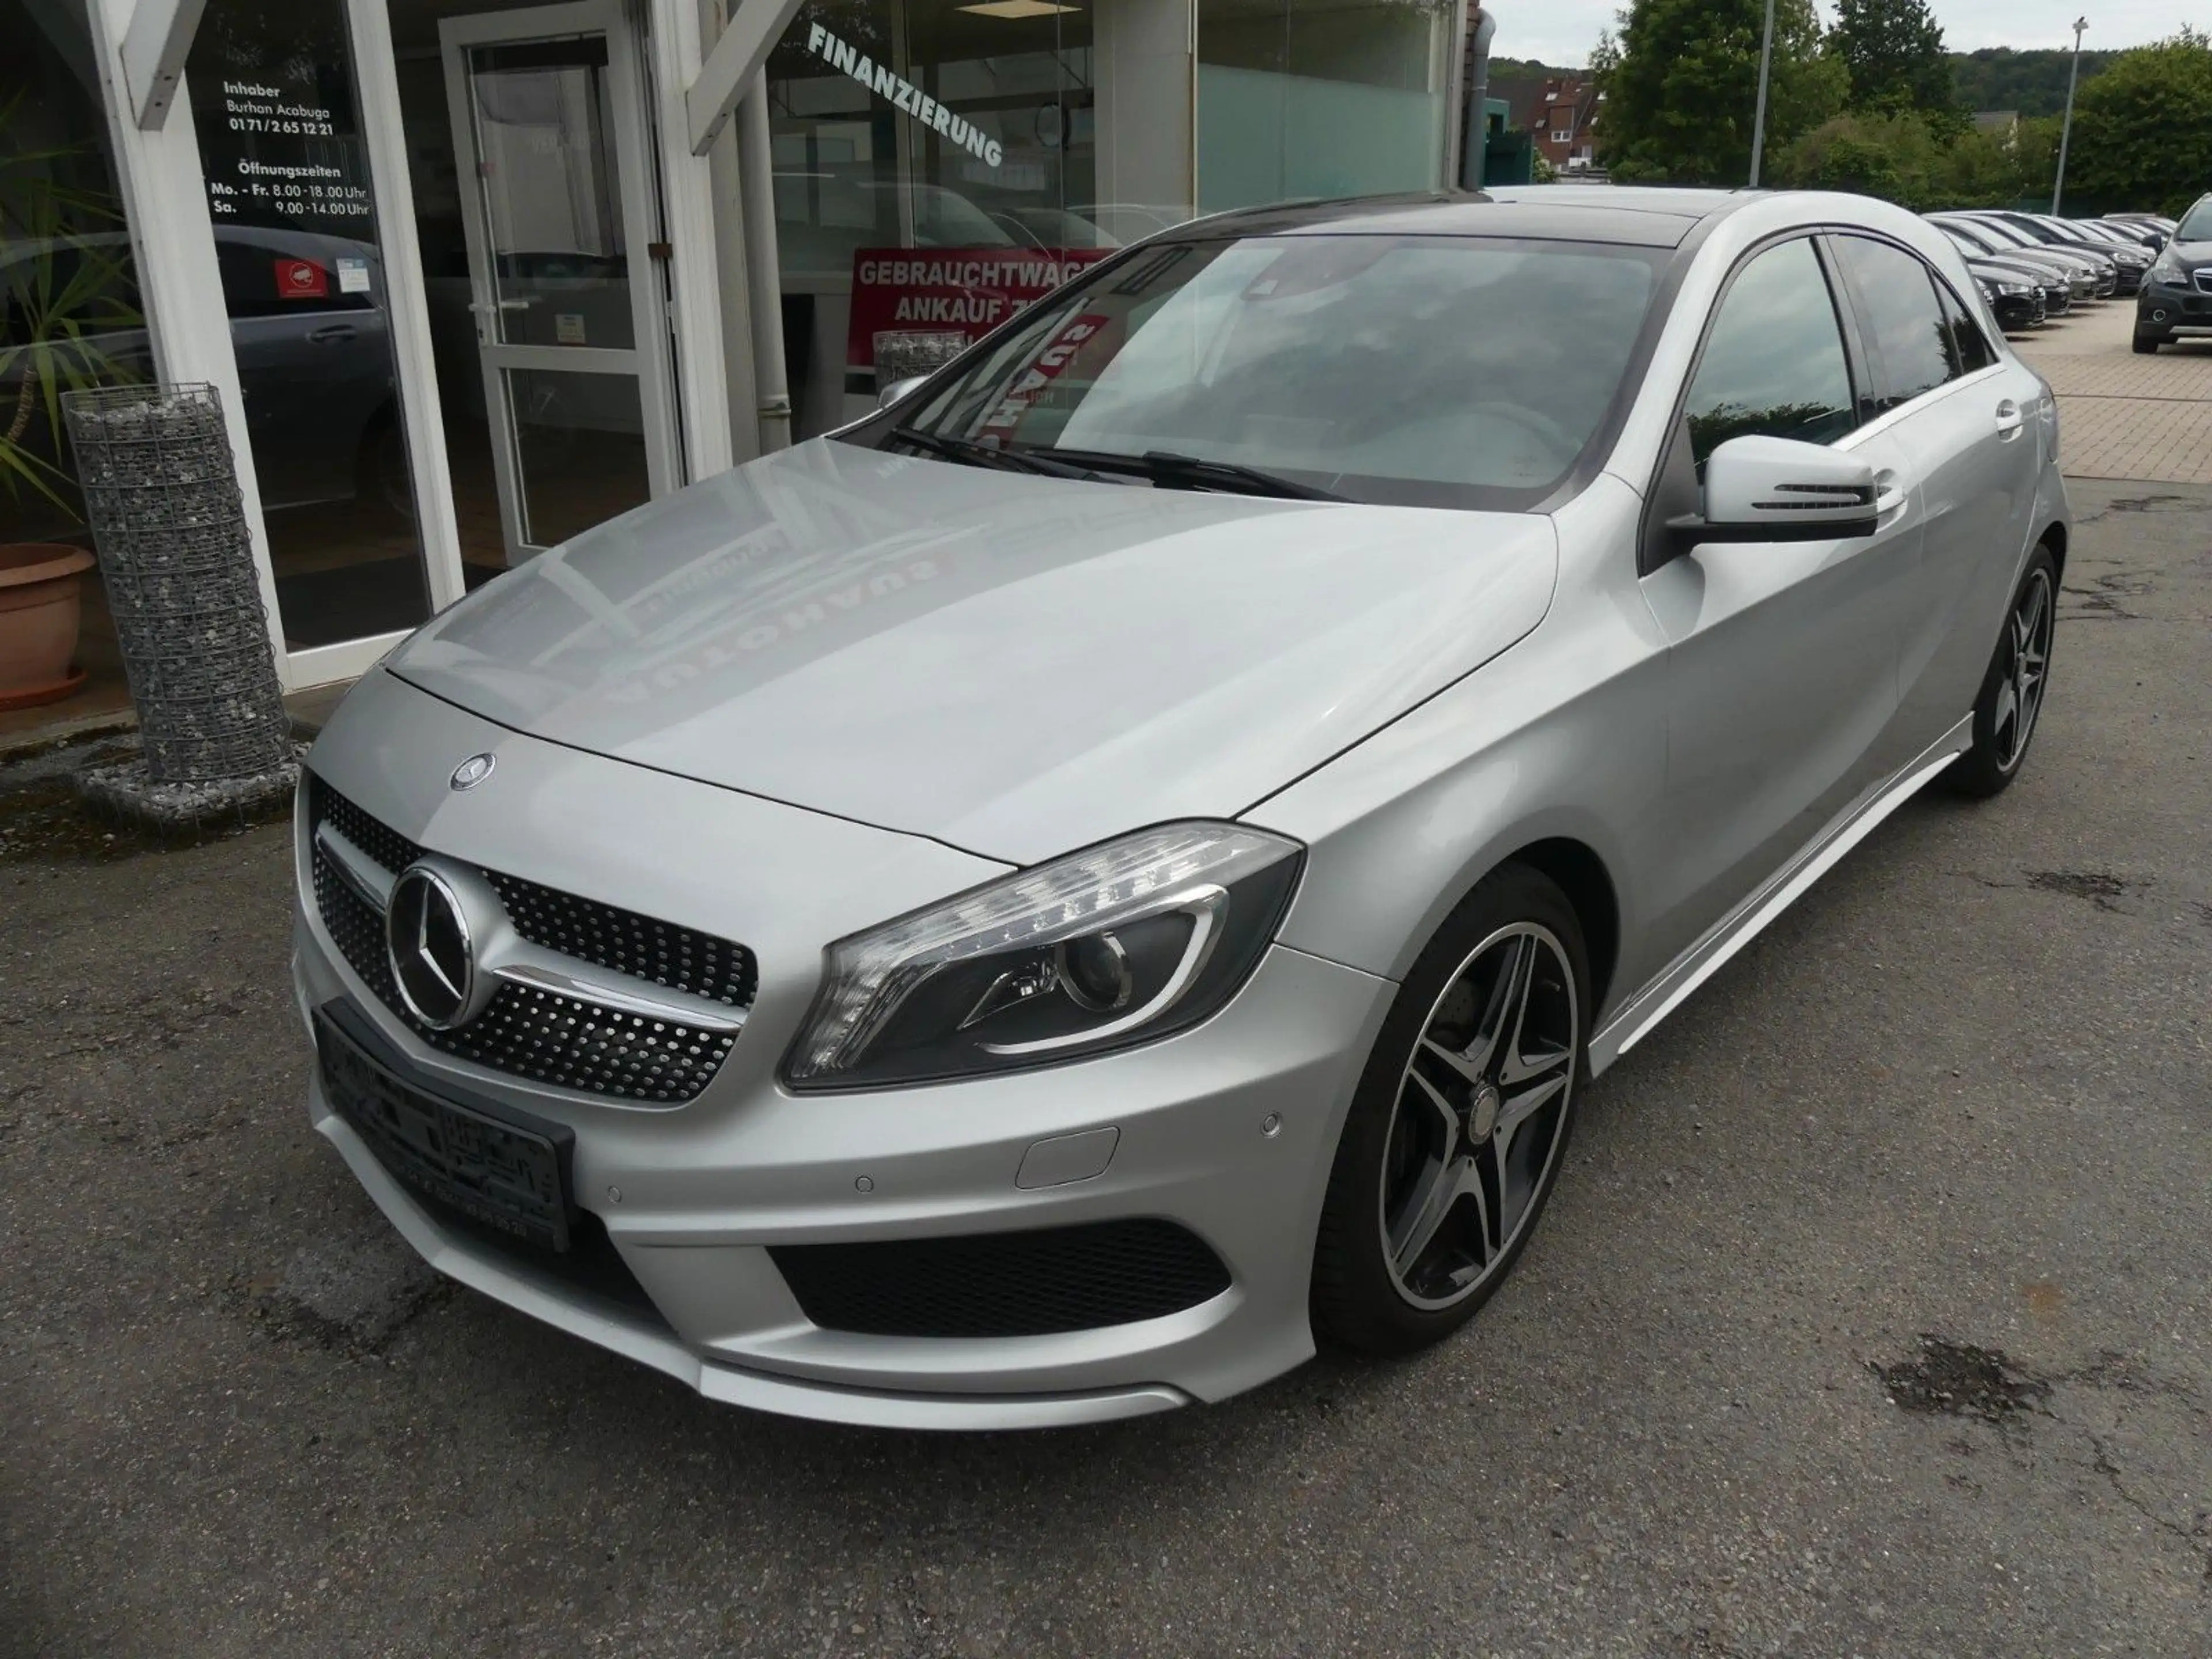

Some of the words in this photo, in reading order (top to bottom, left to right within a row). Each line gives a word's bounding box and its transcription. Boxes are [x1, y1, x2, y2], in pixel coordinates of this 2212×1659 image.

[224, 81, 281, 98] Inhaber
[808, 21, 1002, 167] FINANZIERUNG
[226, 99, 273, 115] Burhan
[238, 158, 341, 179] Öffnungszeiten
[211, 183, 238, 195] Mo.
[252, 184, 269, 196] Fr.
[345, 187, 367, 199] Uhr
[214, 200, 237, 213] Sa.
[347, 204, 369, 215] Uhr
[895, 297, 1002, 323] ANKAUF
